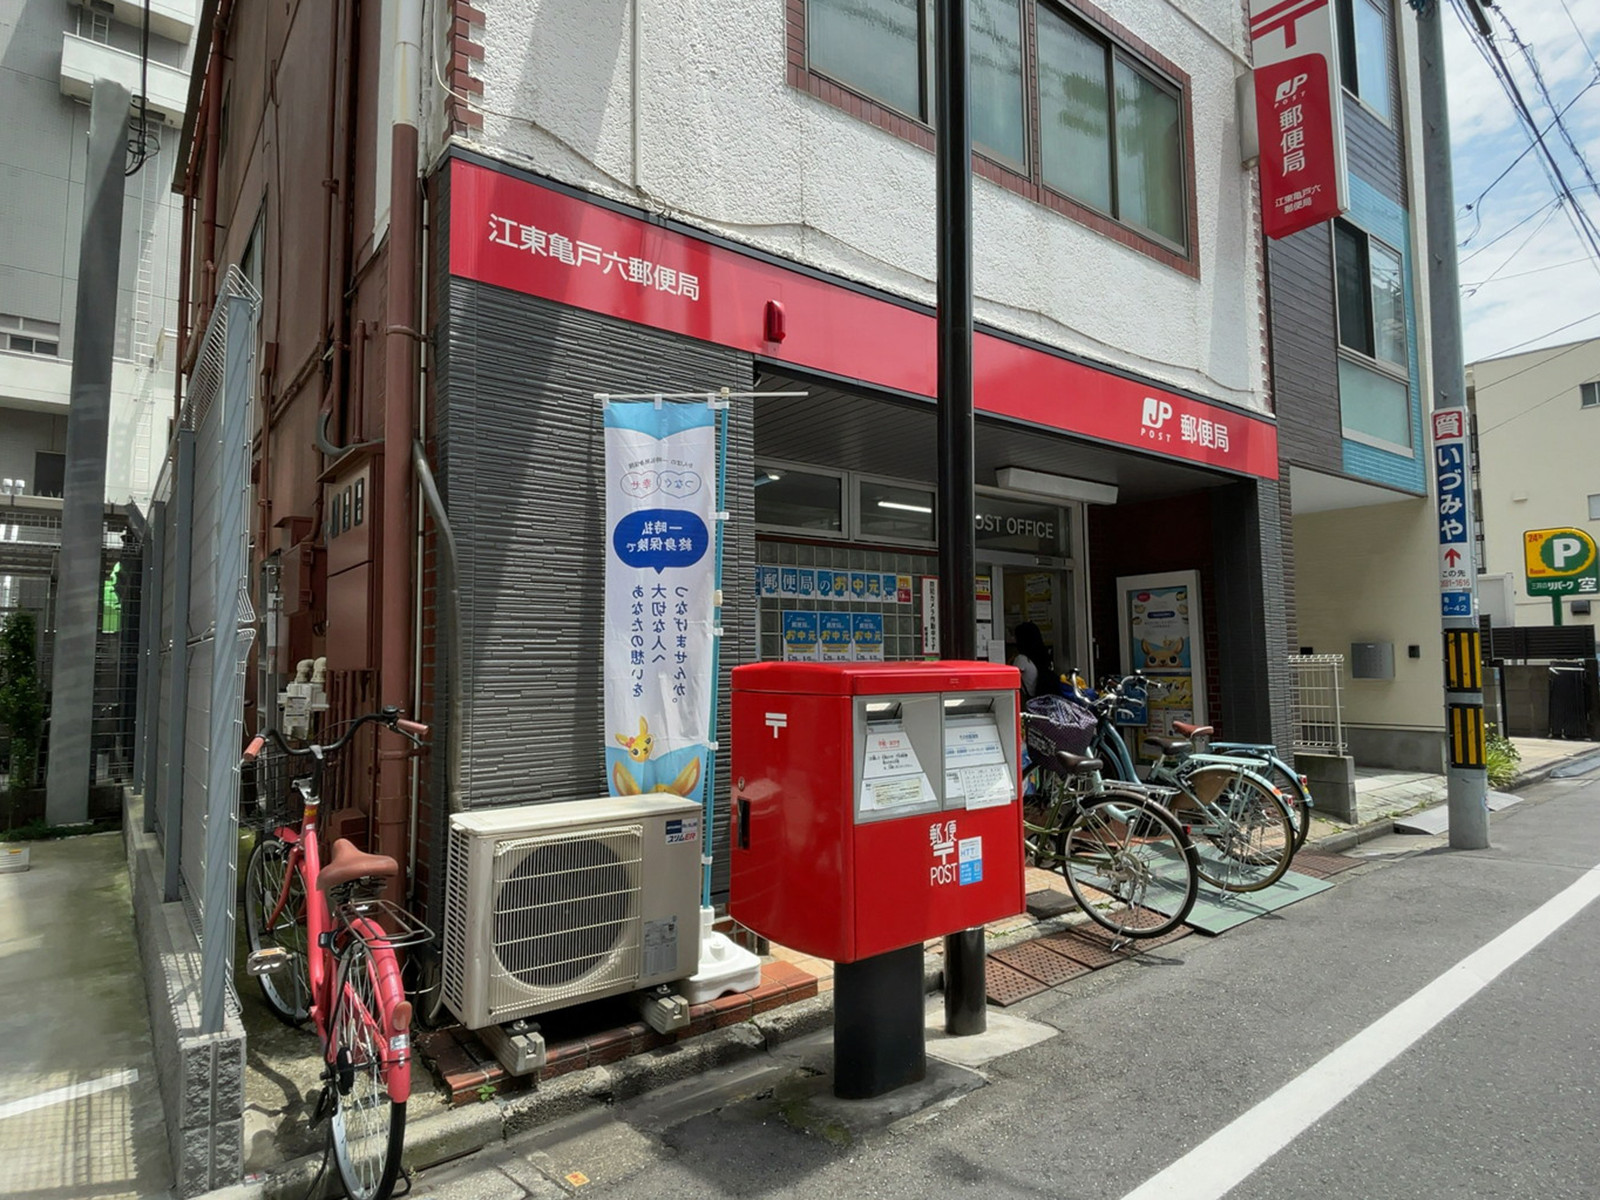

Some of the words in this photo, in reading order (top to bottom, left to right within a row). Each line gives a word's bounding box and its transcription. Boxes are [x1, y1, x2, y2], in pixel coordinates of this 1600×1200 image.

[1274, 90, 1306, 109] POST
[1280, 104, 1305, 178] 郵便局
[1275, 184, 1322, 208] 江東亀戸六
[1284, 198, 1312, 215] 郵便局
[488, 213, 700, 302] 江東亀戸六郵便局
[1140, 427, 1171, 443] POST
[1180, 413, 1229, 453] 郵便局
[1437, 447, 1464, 541] いづみや
[975, 514, 1002, 533] OST
[1006, 517, 1054, 539] OFFICE
[1552, 538, 1581, 568] P
[763, 573, 880, 594] 郵便局のお中元
[1442, 569, 1466, 578] この先
[1578, 577, 1597, 592] 空
[785, 631, 816, 642] お中元
[820, 631, 851, 642] お中元
[854, 632, 882, 642] お中元
[929, 820, 957, 847] 郵便
[930, 862, 958, 887] POST
